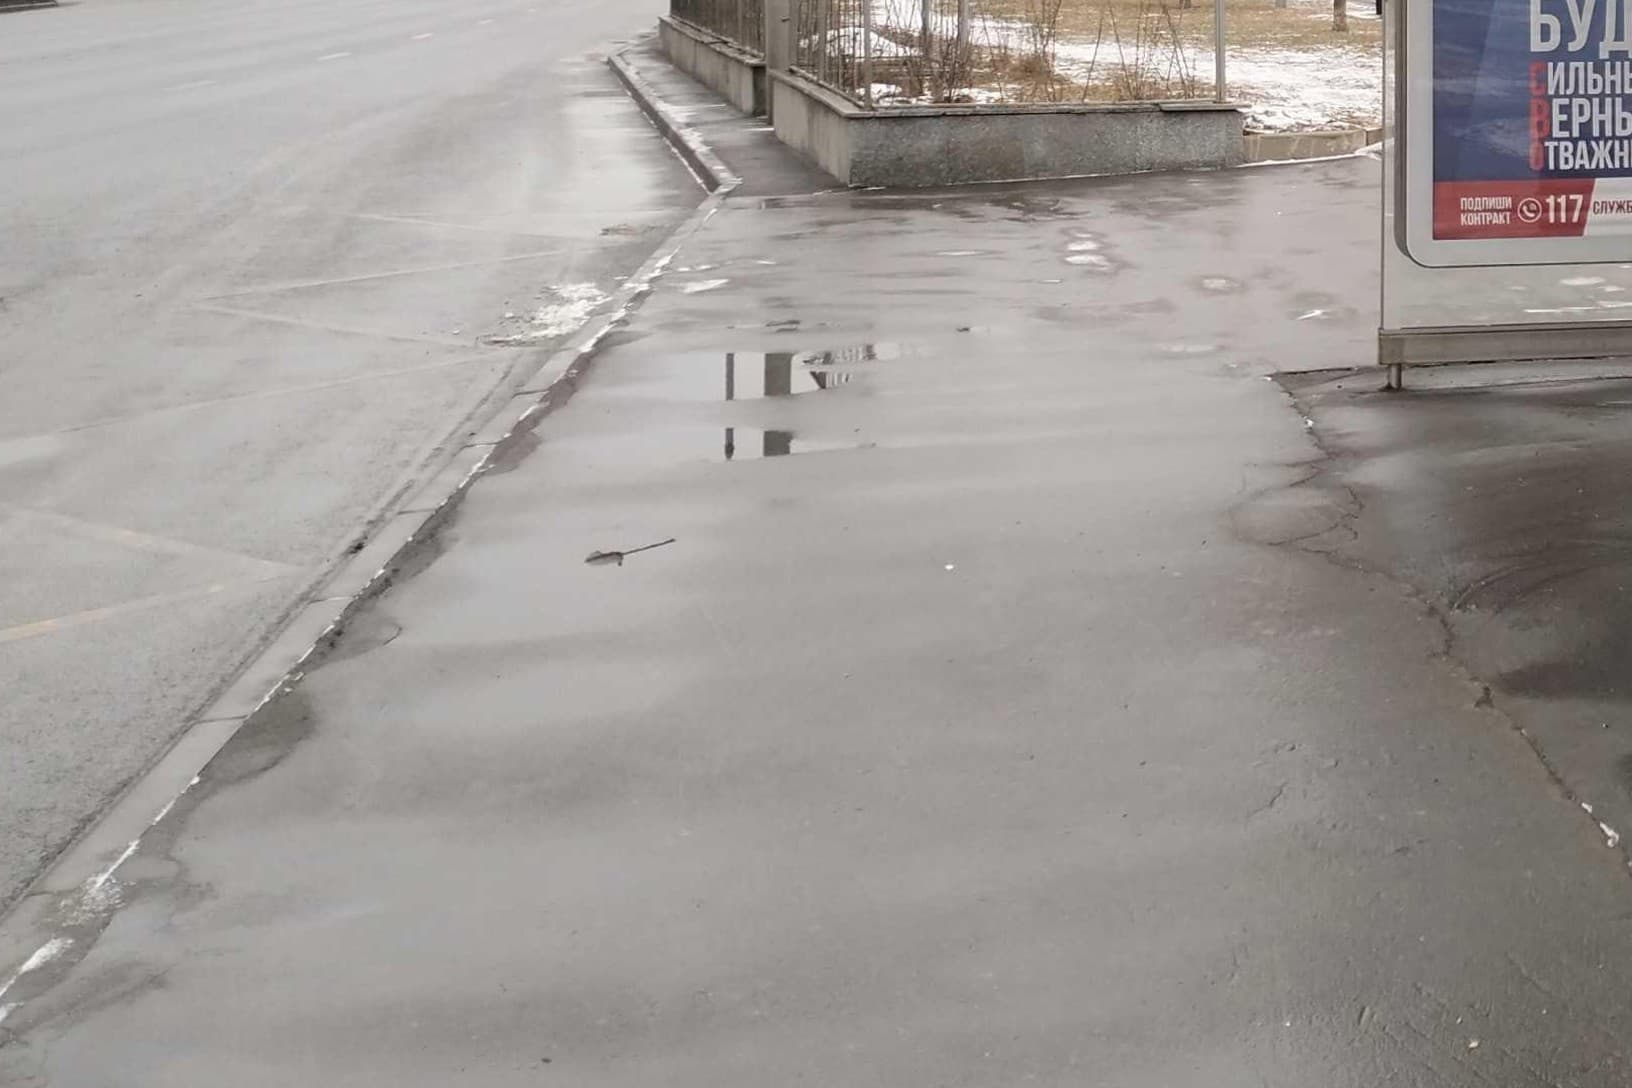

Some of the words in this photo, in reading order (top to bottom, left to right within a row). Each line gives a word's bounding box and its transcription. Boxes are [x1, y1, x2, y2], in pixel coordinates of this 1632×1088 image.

[1460, 197, 1512, 211] ПОДПИШИ
[1545, 194, 1584, 223] 117
[1460, 211, 1511, 226] КОНТРАКТ
